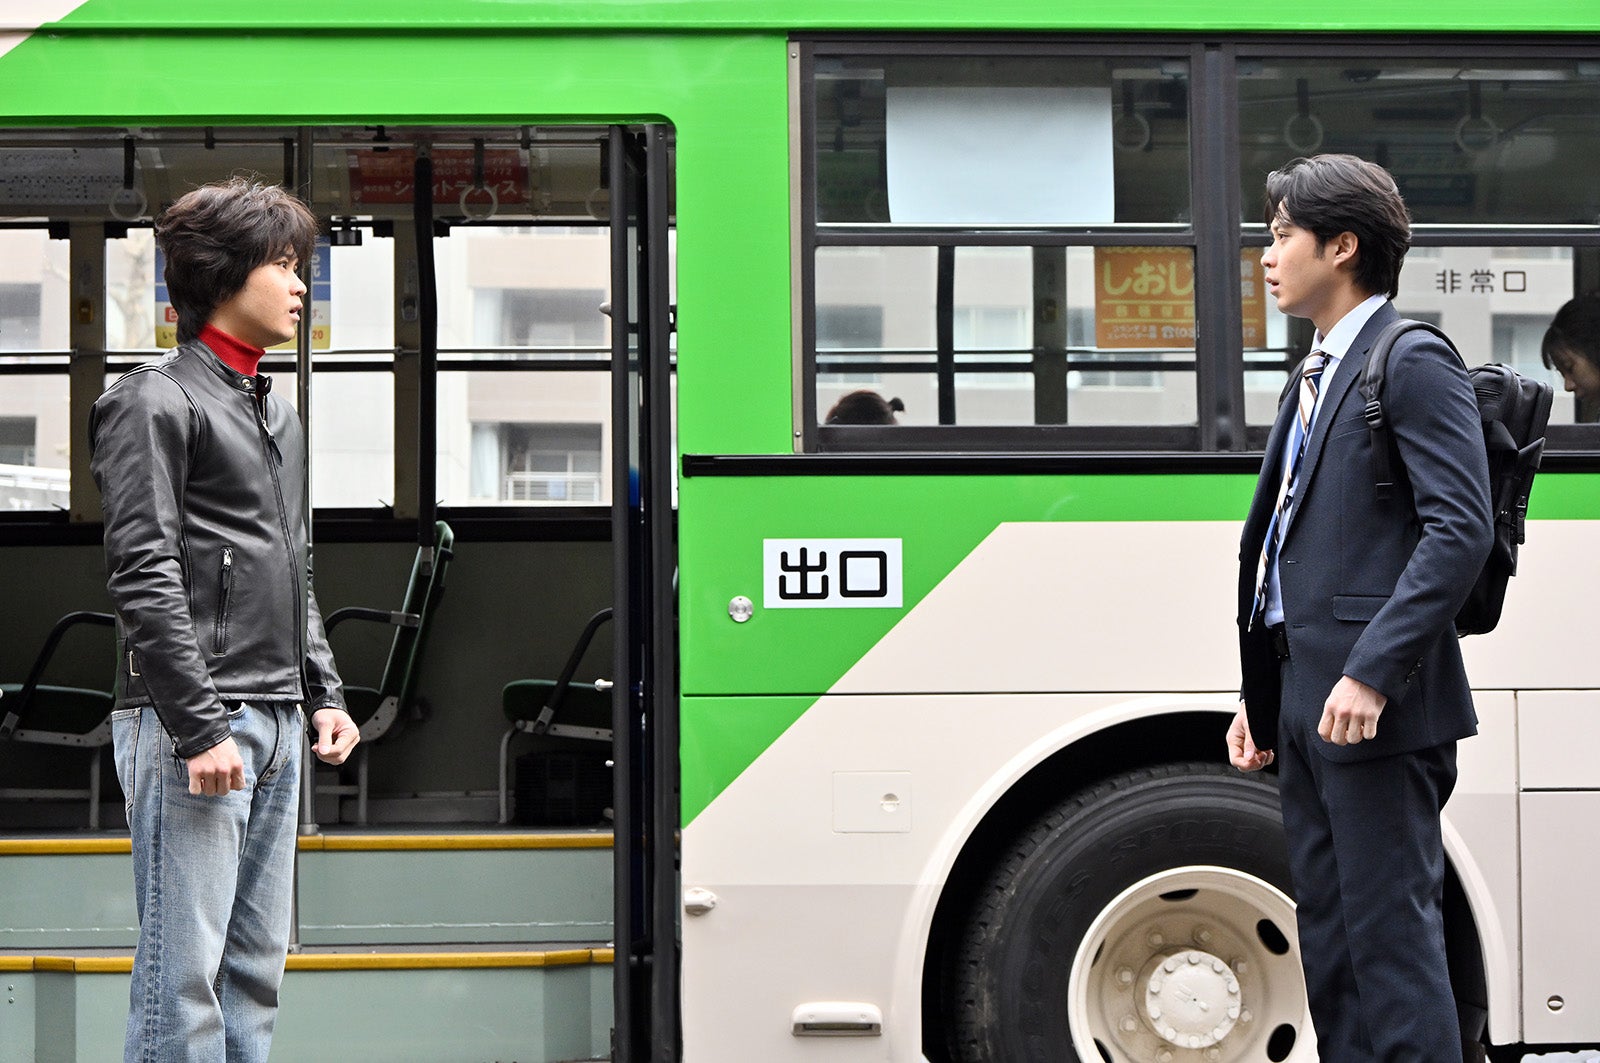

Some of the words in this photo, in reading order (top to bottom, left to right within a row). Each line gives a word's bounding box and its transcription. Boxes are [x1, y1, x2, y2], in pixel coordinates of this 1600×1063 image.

[1436, 269, 1526, 293] 非常口
[779, 547, 887, 599] 出口
